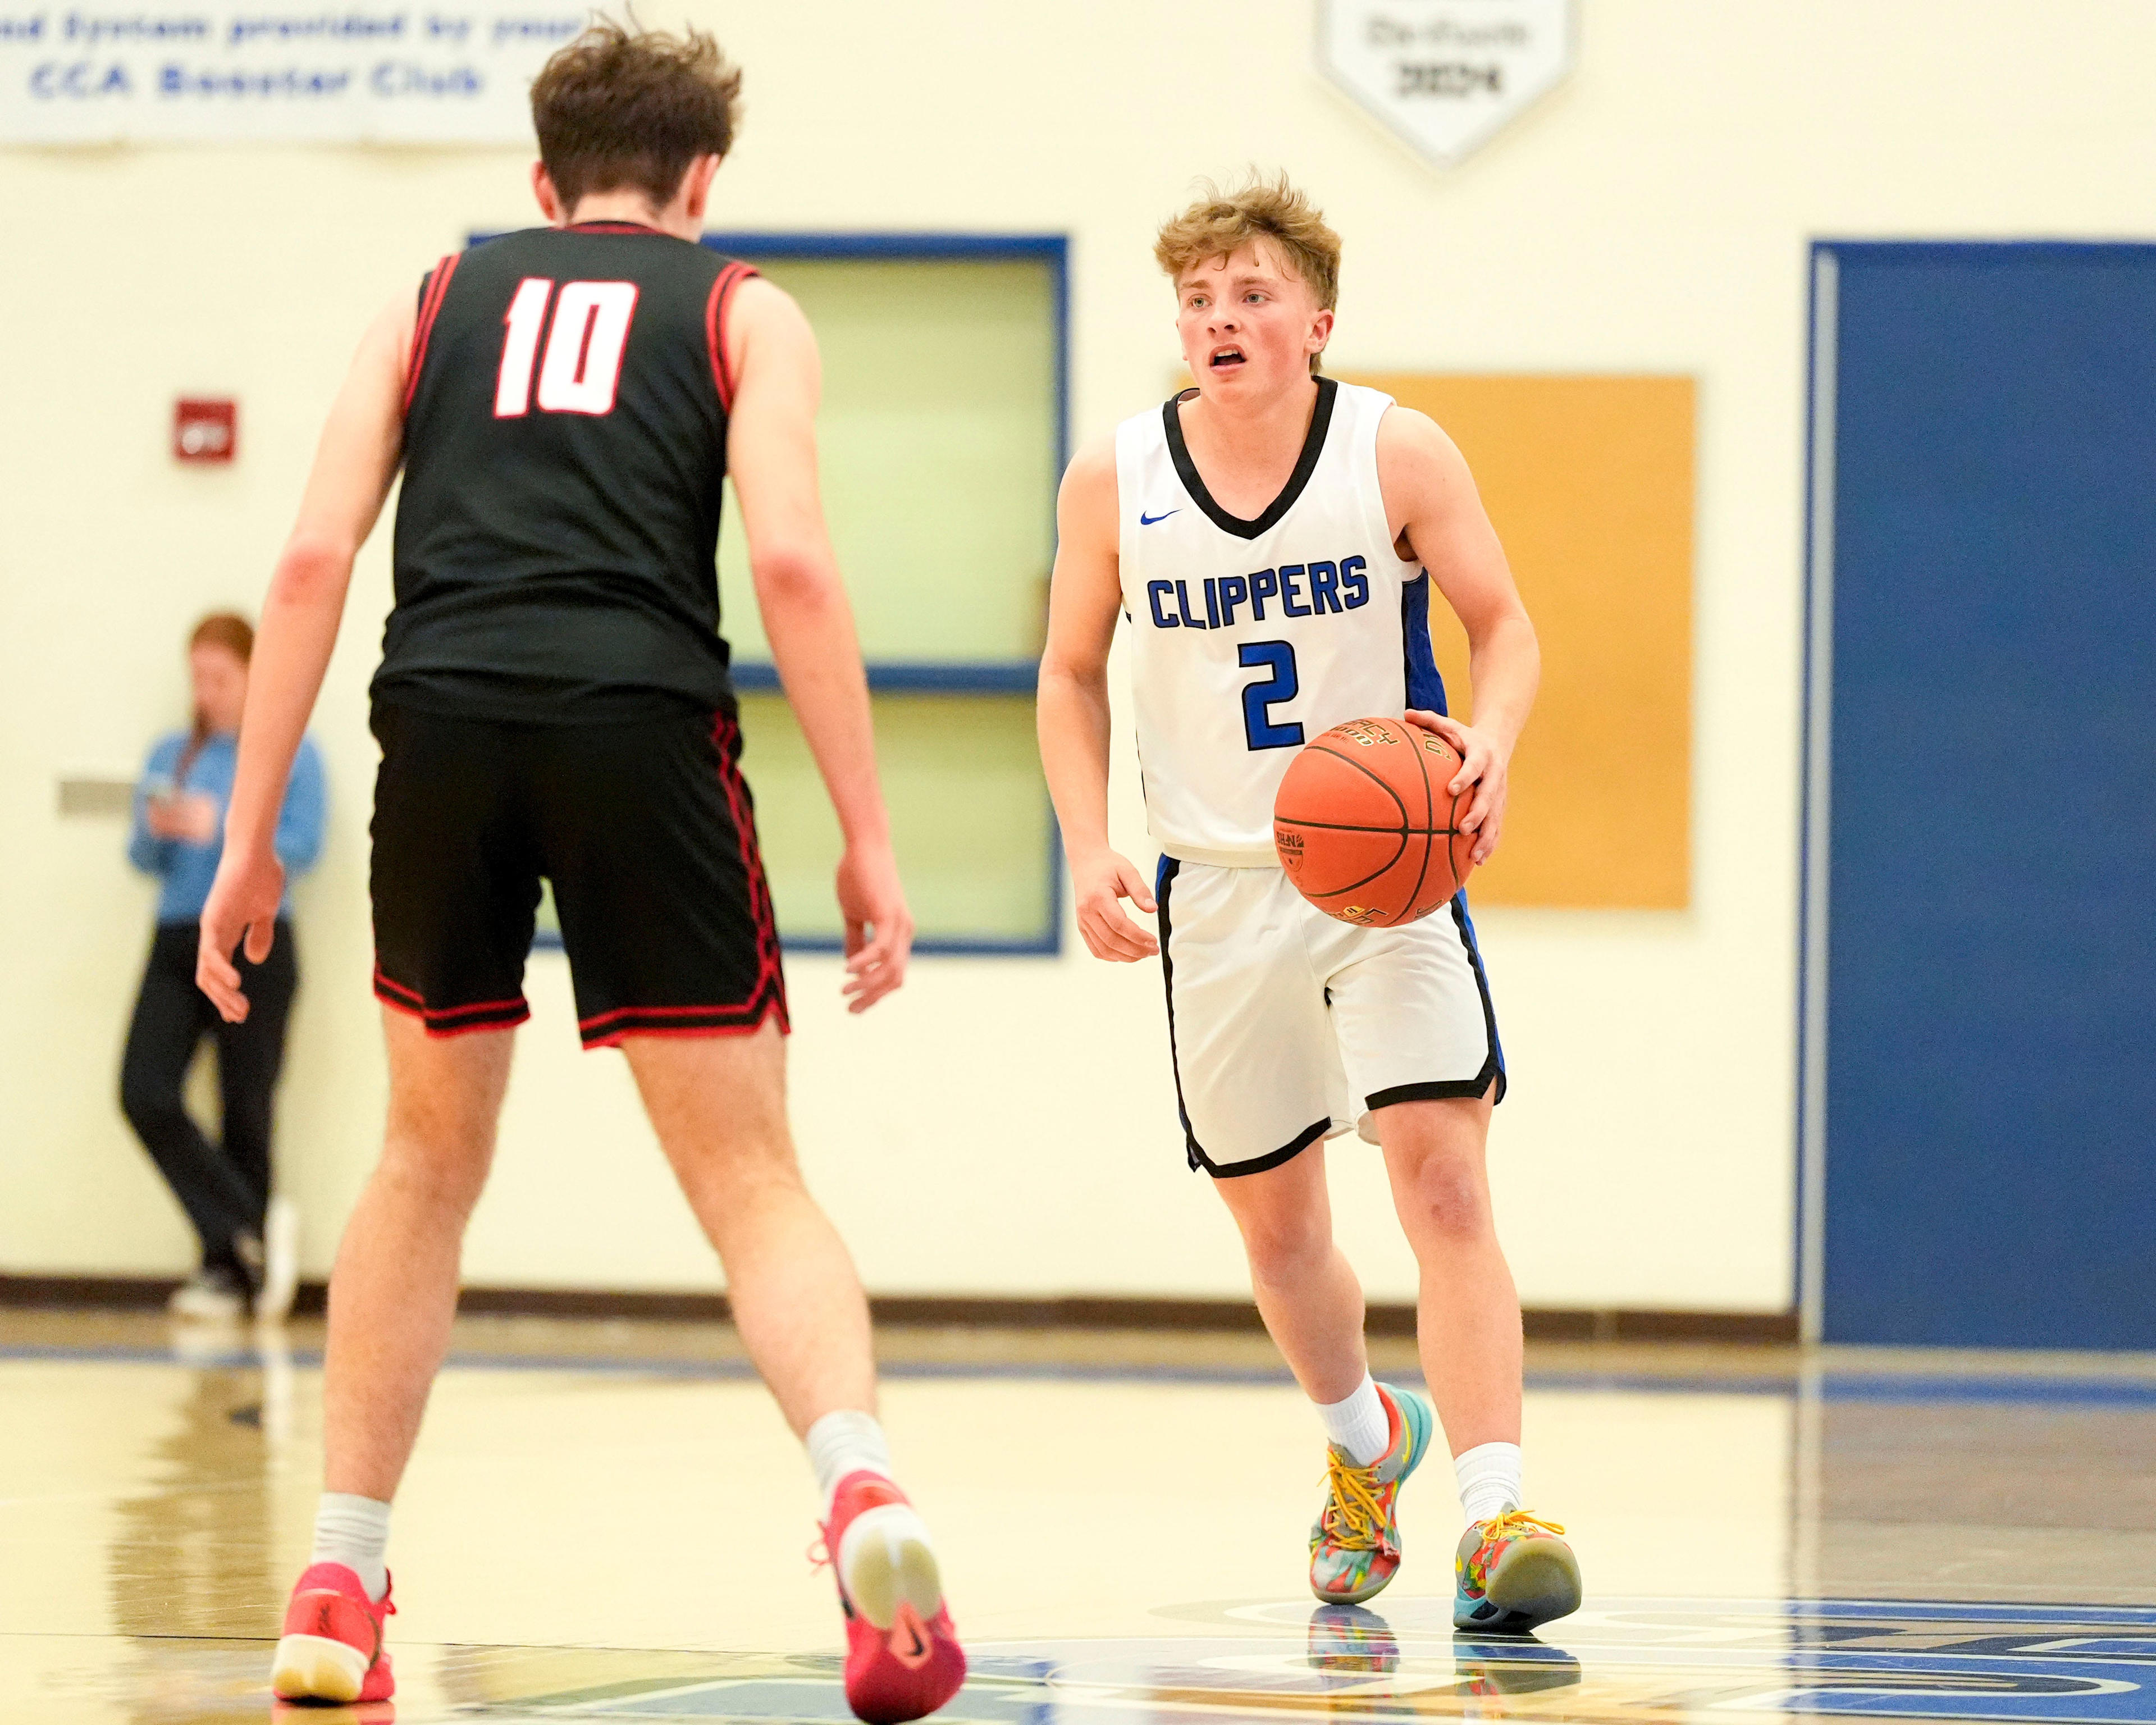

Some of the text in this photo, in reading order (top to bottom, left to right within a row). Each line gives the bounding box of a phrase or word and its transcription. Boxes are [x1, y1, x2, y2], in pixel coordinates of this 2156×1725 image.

[30, 61, 130, 99] CCA
[493, 276, 640, 418] 10
[1148, 555, 1369, 630] CLIPPERS
[1237, 640, 1305, 751] 2
